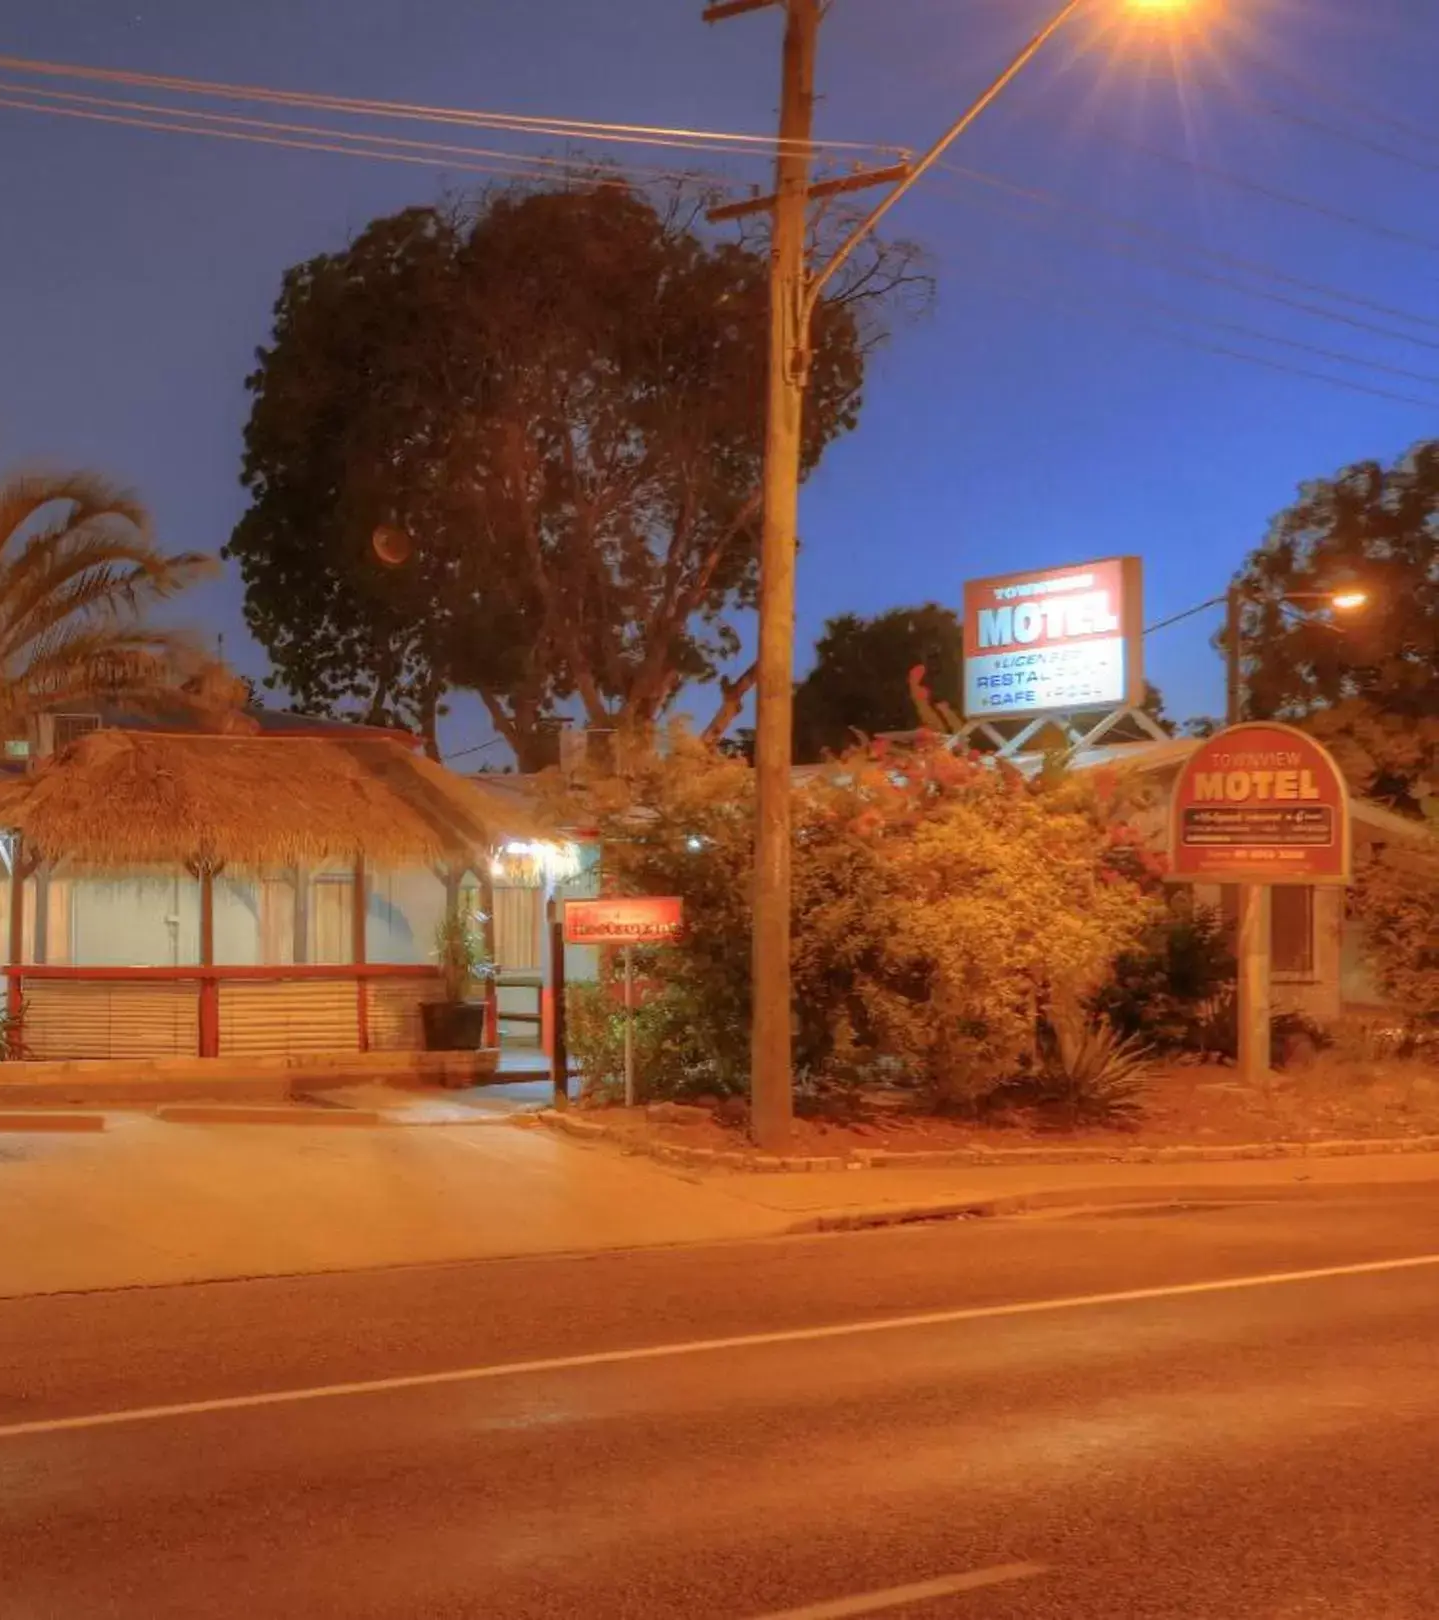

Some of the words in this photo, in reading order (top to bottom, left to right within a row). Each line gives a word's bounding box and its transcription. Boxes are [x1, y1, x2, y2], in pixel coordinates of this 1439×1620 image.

[978, 591, 1117, 648] MOTEL
[976, 662, 1107, 689] RESTA
[989, 690, 1037, 706] CAFE
[1194, 770, 1320, 801] MOTEL
